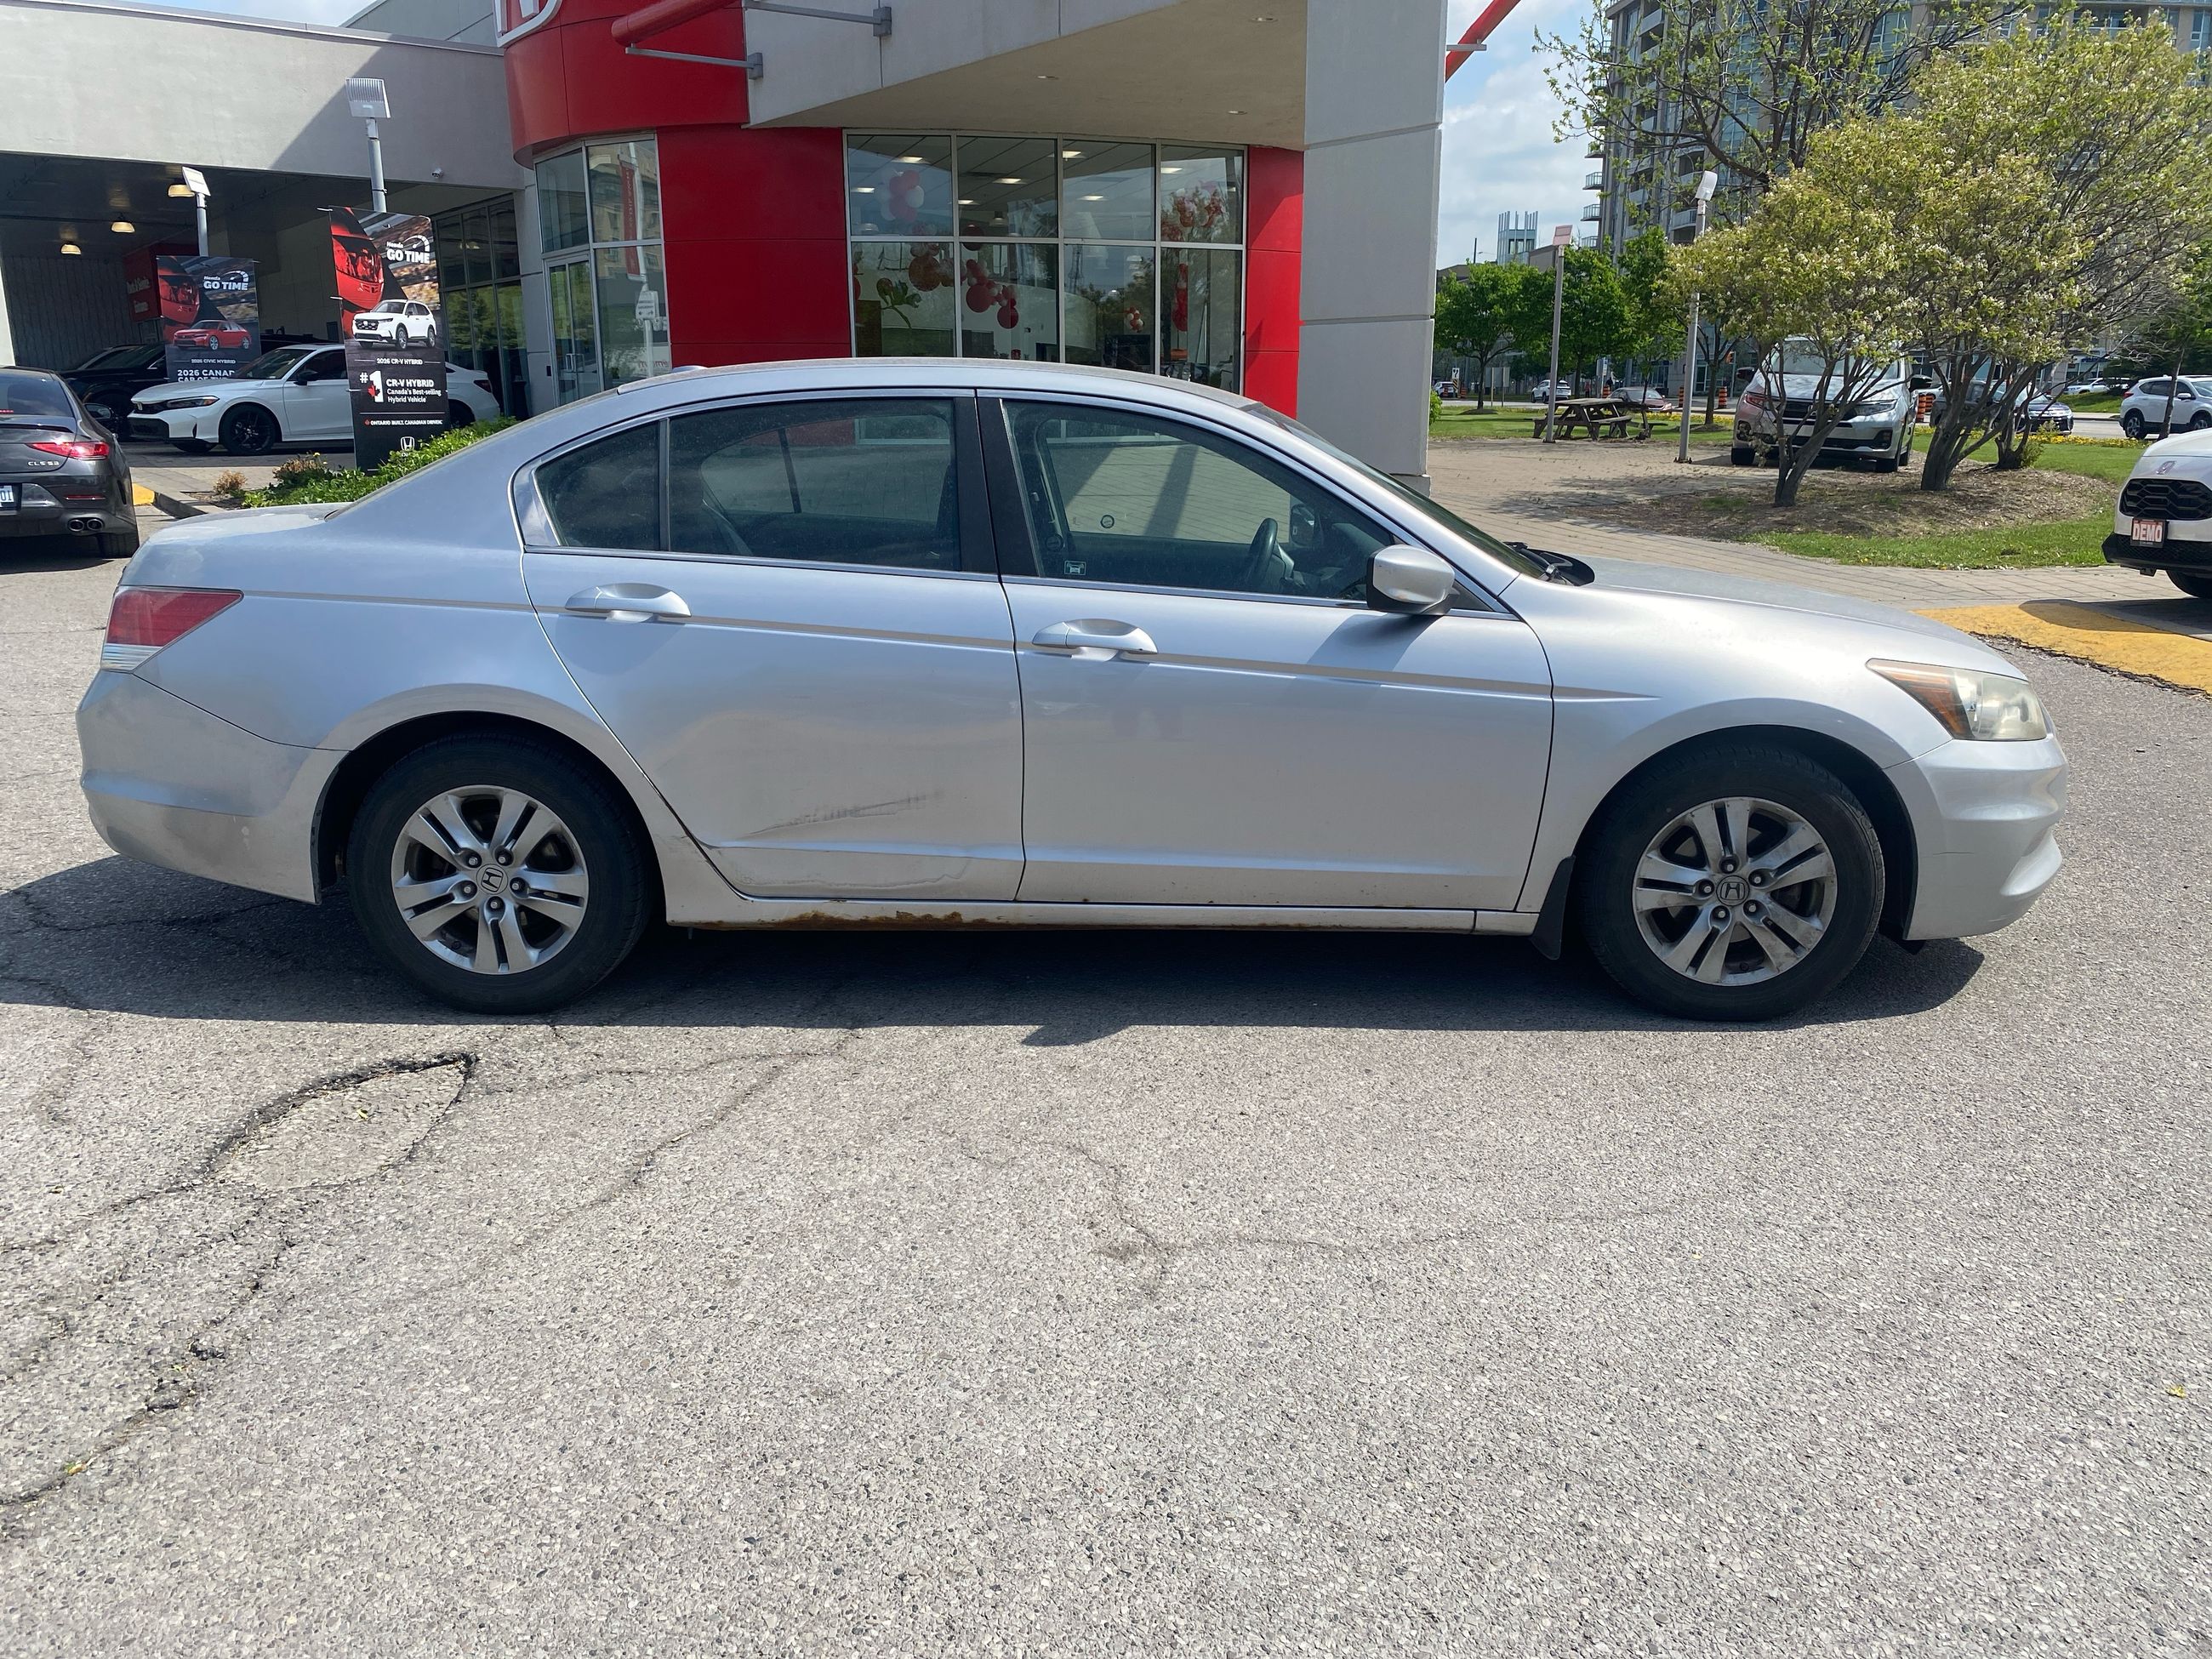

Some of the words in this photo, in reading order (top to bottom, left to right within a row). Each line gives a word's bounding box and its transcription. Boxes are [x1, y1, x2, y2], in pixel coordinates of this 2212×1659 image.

[386, 248, 404, 261] GO
[404, 250, 430, 265] TIME
[203, 281, 220, 289] GO
[221, 282, 248, 291] TIME
[385, 379, 405, 387] CR-V
[406, 379, 435, 388] HYBRID
[412, 388, 442, 396] Best-selling
[387, 396, 407, 404] Hybrid
[2132, 523, 2163, 543] DEMO
